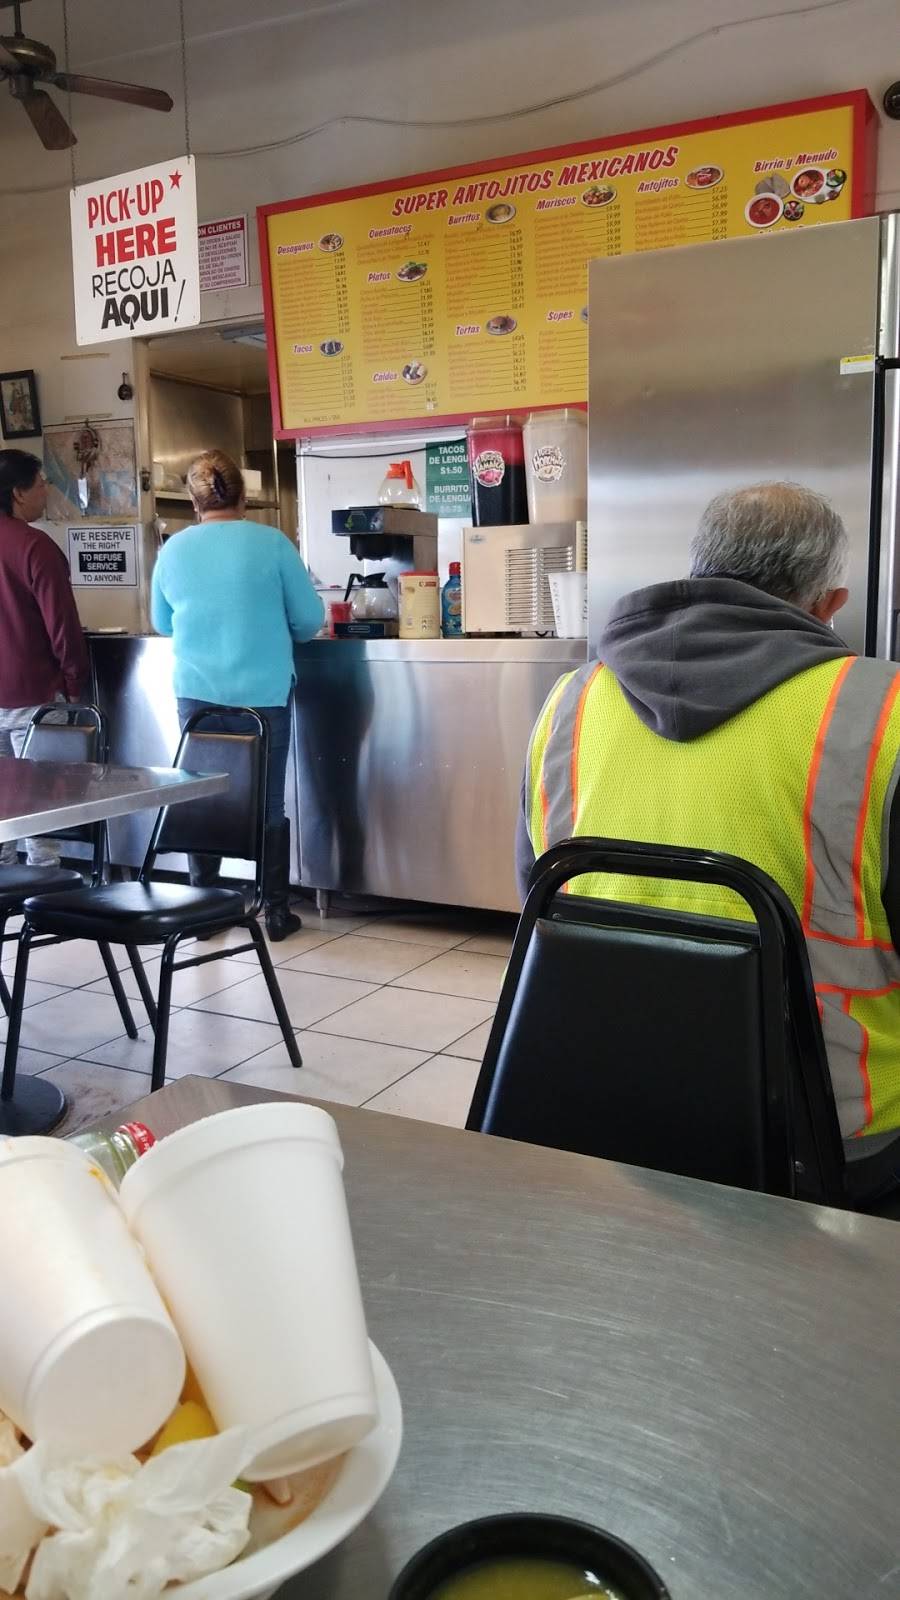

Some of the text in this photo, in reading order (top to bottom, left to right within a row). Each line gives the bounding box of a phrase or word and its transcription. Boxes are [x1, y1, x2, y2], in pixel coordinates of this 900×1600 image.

[755, 149, 838, 172] Birria y Menudo
[391, 146, 679, 217] SUPER ANTOJITOS MEXICANOS
[638, 178, 679, 193] Antojitos
[87, 179, 165, 229] PICK-UP
[536, 197, 577, 210] Mariscos
[448, 213, 480, 225] Burritos
[207, 220, 241, 234] CLIENTES
[368, 225, 413, 239] Quesatacos
[95, 217, 177, 267] HERE
[278, 242, 314, 255] Desayunos
[92, 258, 177, 298] RECOJA
[368, 272, 391, 281] Platos
[547, 311, 574, 321] Sopes
[456, 326, 480, 336] Tortas
[294, 345, 312, 353] Tacos
[373, 372, 398, 382] Caldos
[438, 445, 465, 455] TACOS
[429, 455, 469, 465] DE LENGU
[440, 466, 463, 475] $1.50
[429, 495, 441, 503] DE
[71, 531, 131, 541] WE RESERVE
[82, 542, 120, 550] THE RIGHT
[82, 553, 123, 562] TO REFUSE
[87, 562, 119, 571] SERVICE
[83, 574, 124, 582] TO ANYONE
